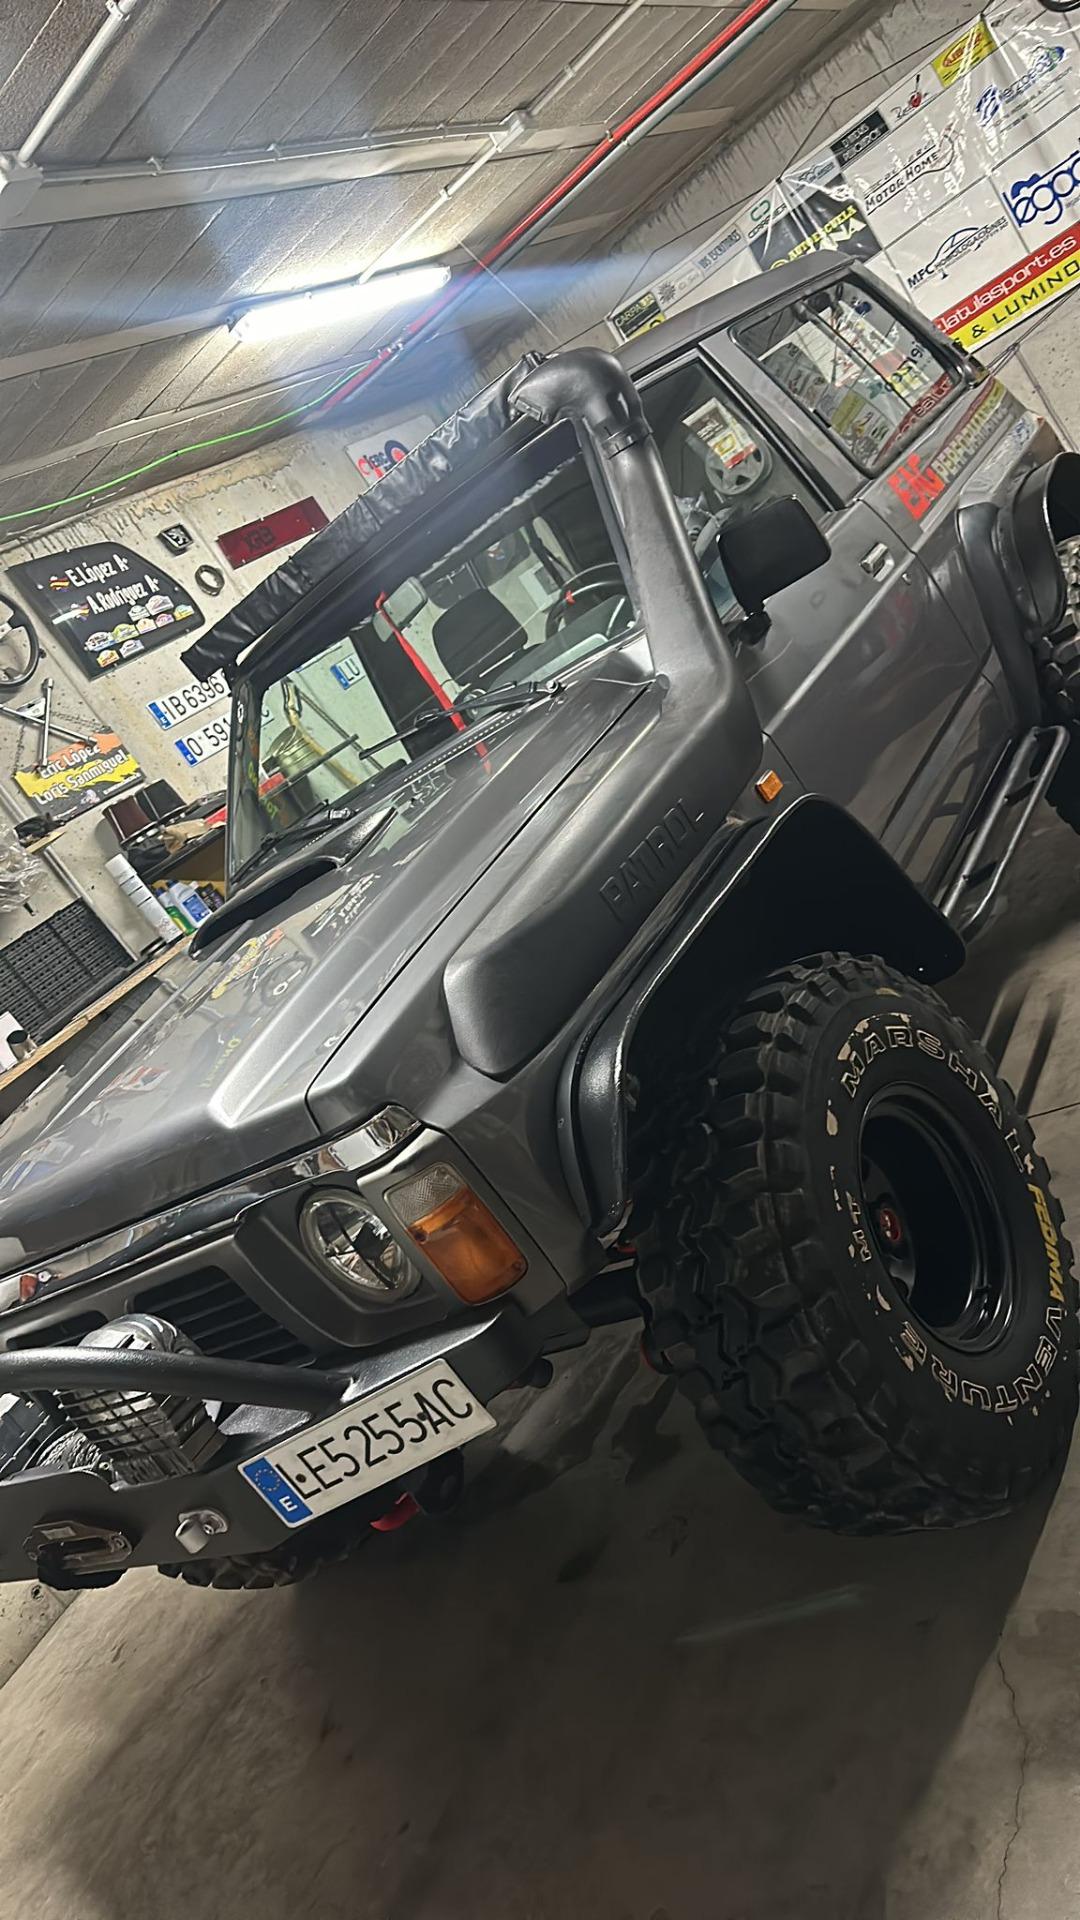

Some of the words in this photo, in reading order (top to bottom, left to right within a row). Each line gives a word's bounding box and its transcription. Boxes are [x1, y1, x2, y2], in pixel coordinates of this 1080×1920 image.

[865, 180, 904, 210] MOTOR
[904, 152, 938, 181] HOME
[788, 206, 857, 262] AUTOESCUELA
[907, 261, 936, 288] MFC
[971, 324, 986, 338] &
[33, 779, 69, 805] Loris
[66, 749, 129, 790] Sanmiguel
[64, 741, 101, 769] López
[600, 798, 704, 922] PATROL
[840, 1025, 1025, 1175] MARSHAL
[1027, 1183, 1066, 1302] FEDIMA
[276, 1379, 473, 1499] LE5255AC
[279, 1496, 298, 1512] E
